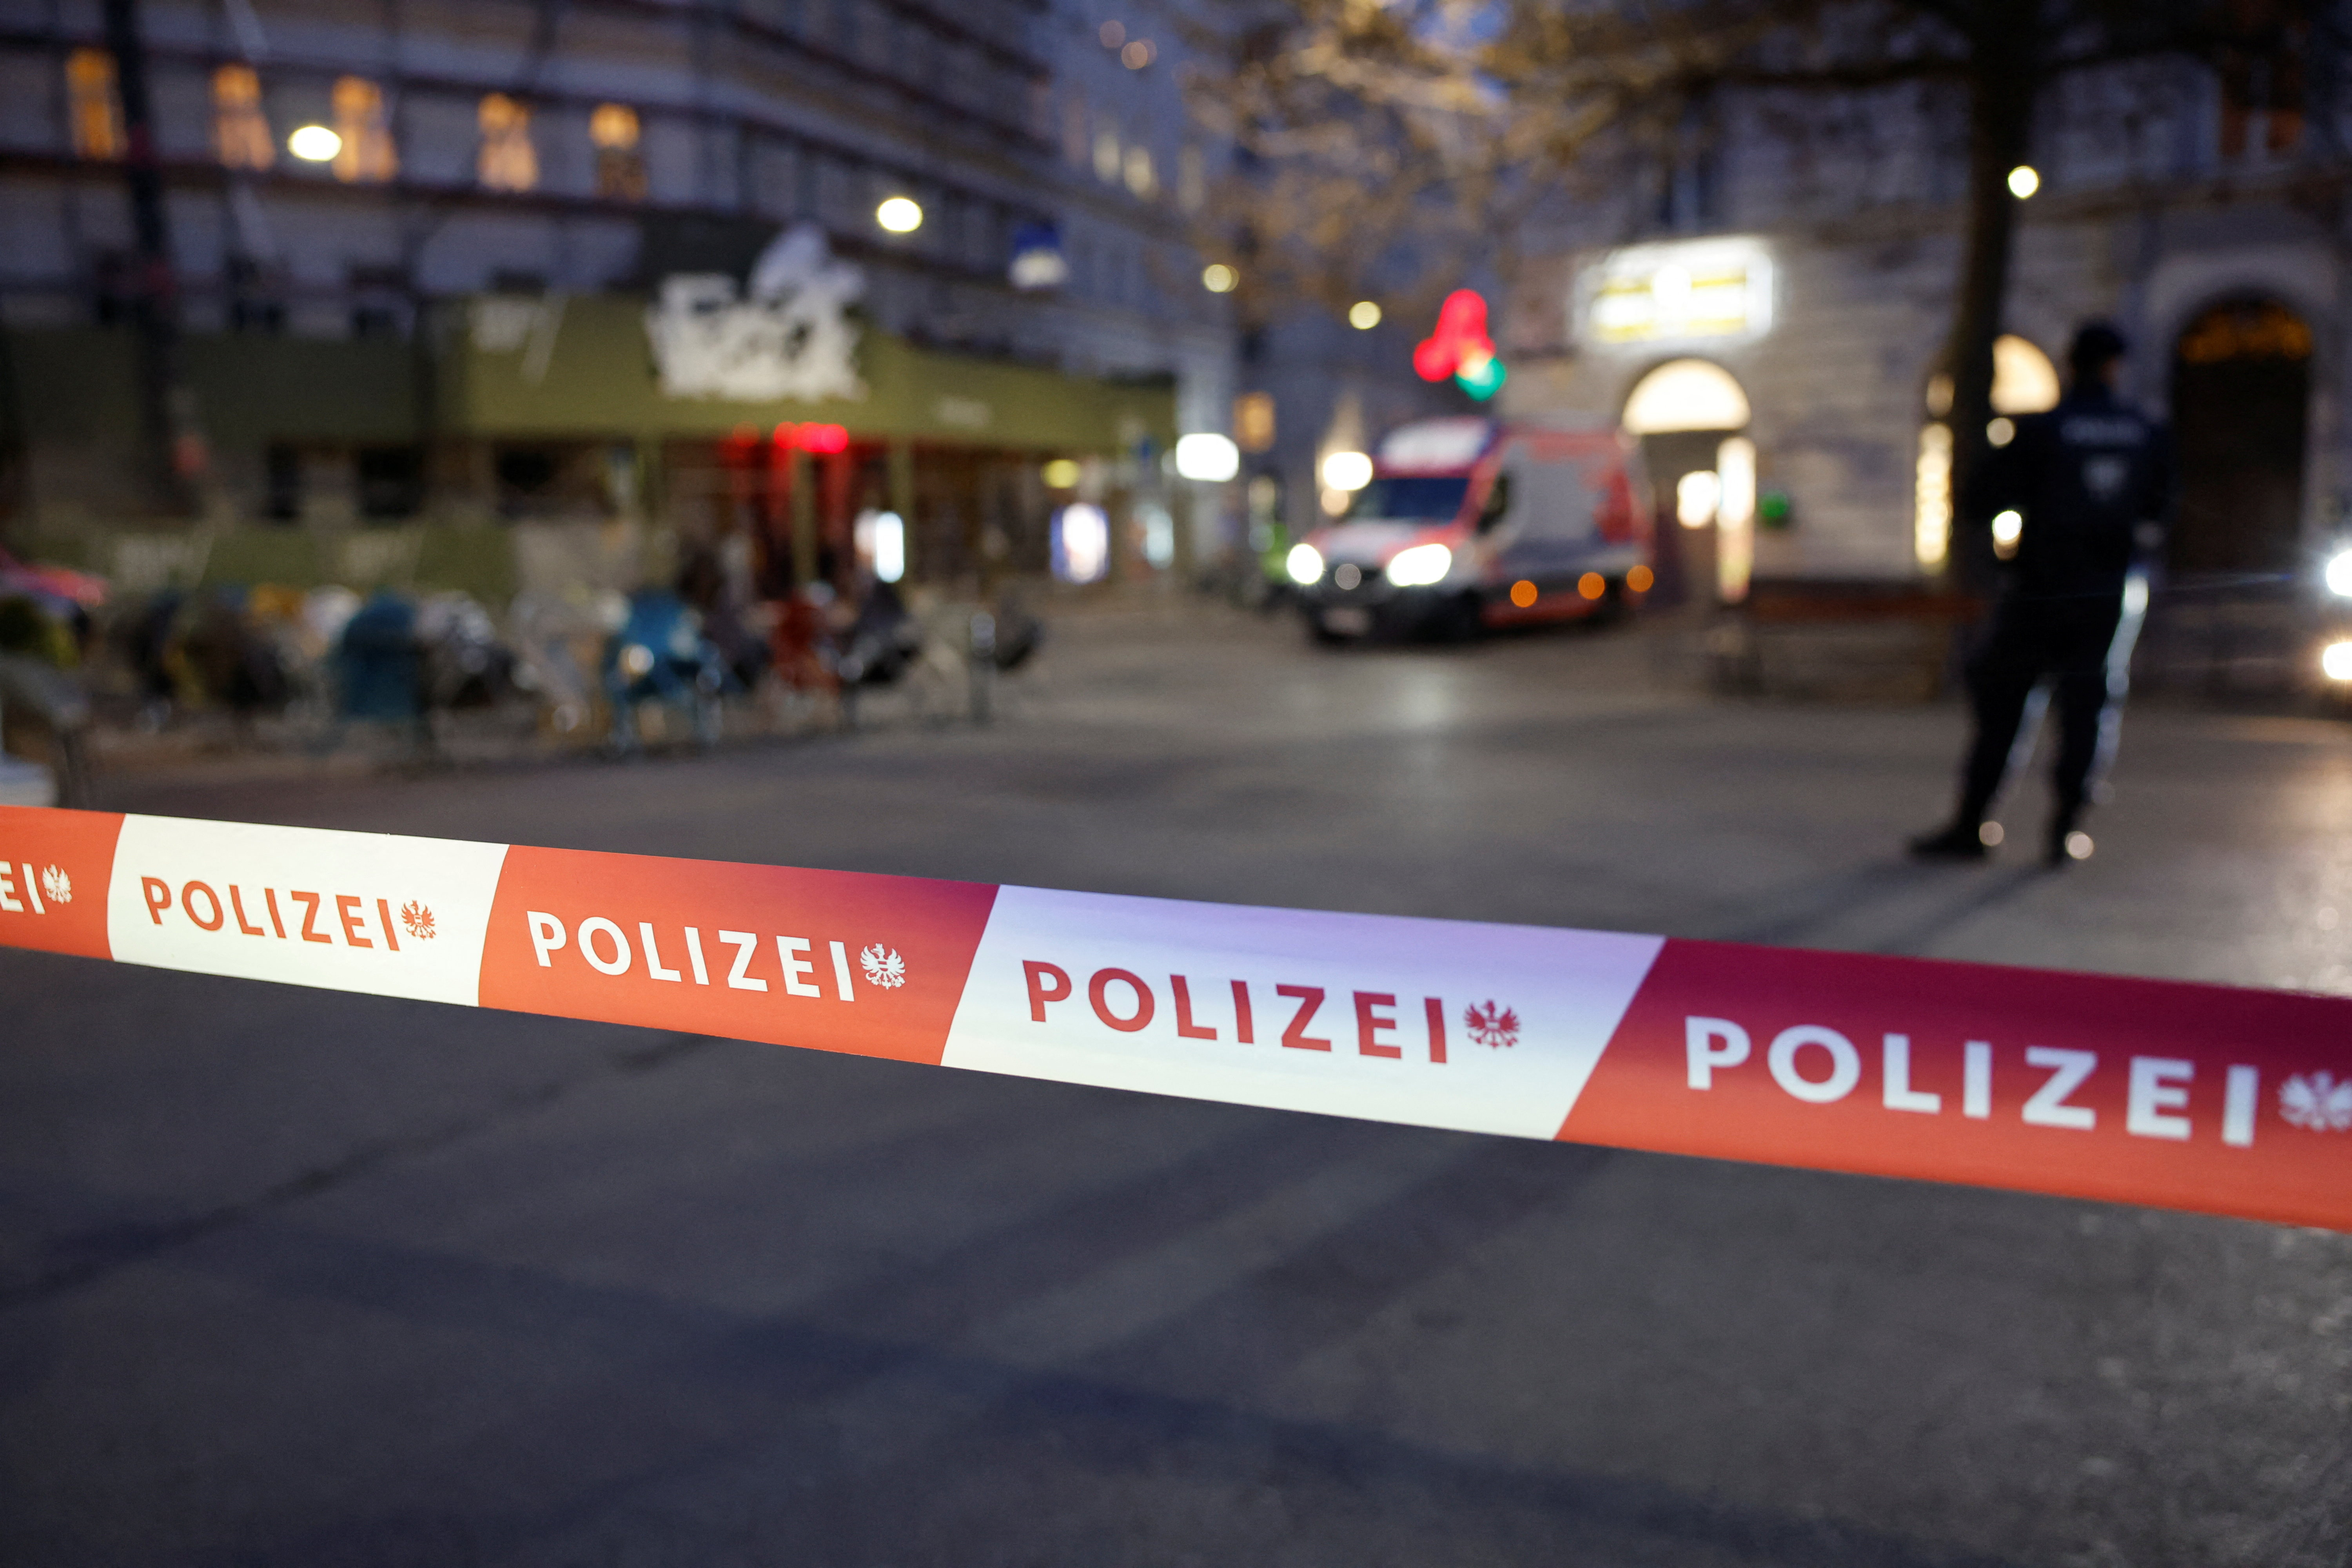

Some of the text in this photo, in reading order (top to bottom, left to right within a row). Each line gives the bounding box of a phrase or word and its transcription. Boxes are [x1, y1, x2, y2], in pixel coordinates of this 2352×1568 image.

[0, 860, 45, 915] EI
[141, 876, 400, 951] POLIZEI
[526, 910, 855, 1002] POLIZEI
[1022, 959, 1448, 1064] POLIZEI
[1684, 1014, 2259, 1148] POLIZEI
